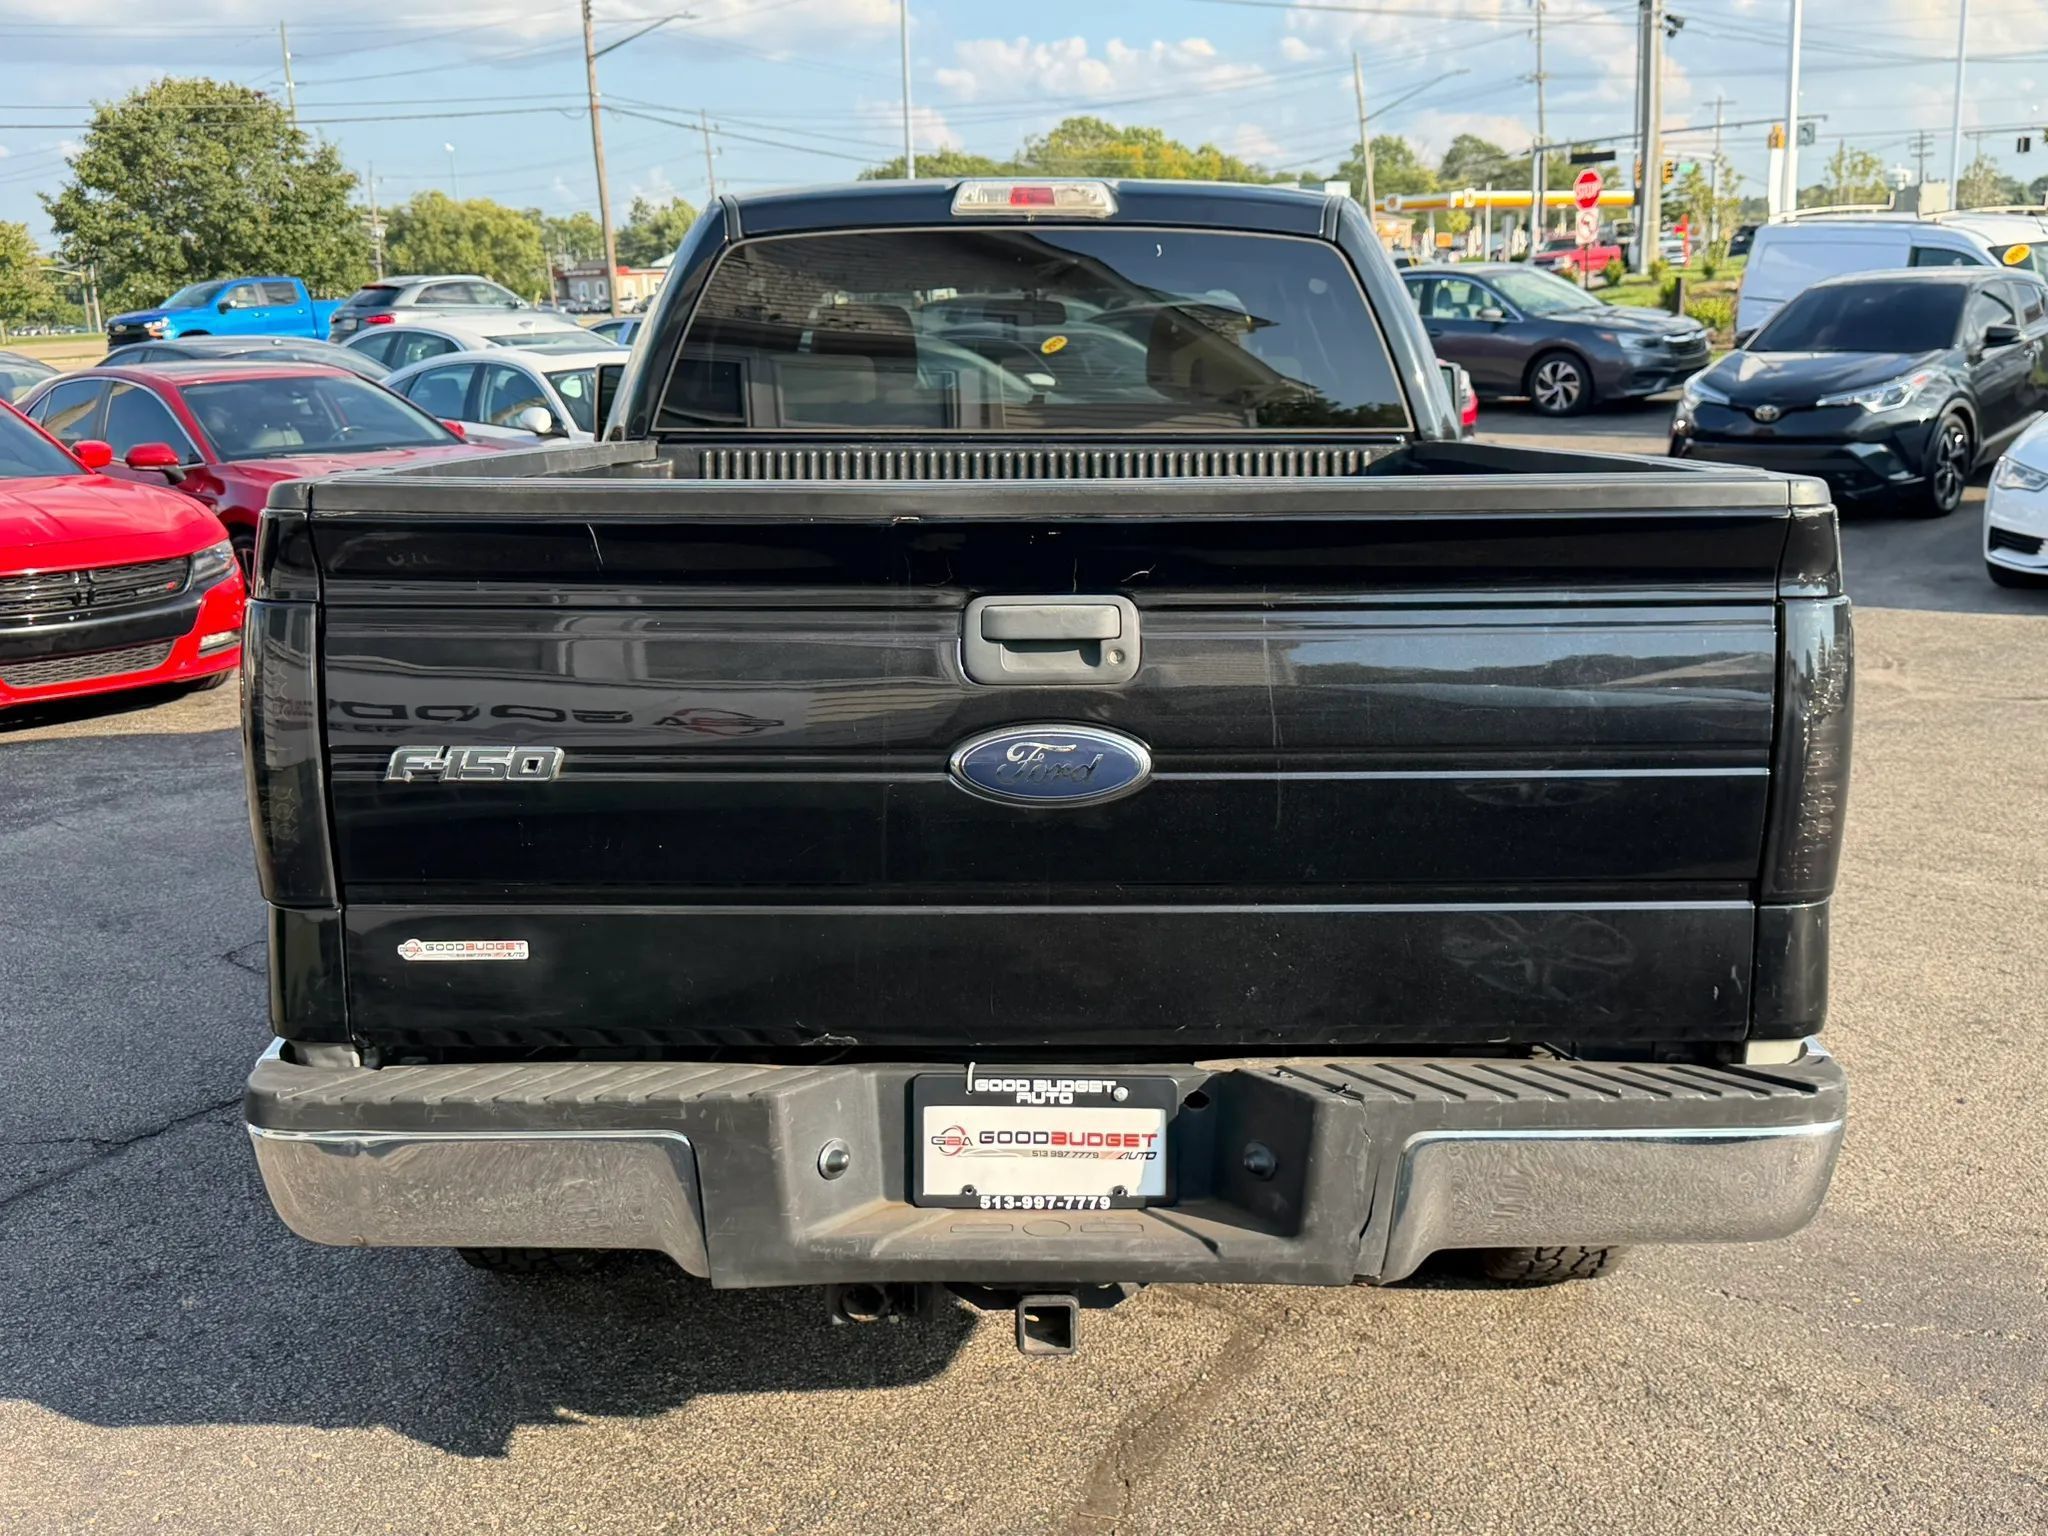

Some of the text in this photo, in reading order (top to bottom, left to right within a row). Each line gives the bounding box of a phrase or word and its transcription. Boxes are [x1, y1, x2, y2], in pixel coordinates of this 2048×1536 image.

[384, 746, 566, 783] F-150
[996, 741, 1104, 786] Ford
[425, 942, 525, 951] GOODBUDGET
[974, 1079, 1117, 1093] GOOD BUDGET
[1016, 1092, 1074, 1104] AUTO
[979, 1131, 1158, 1148] GOODBUDGET
[1116, 1151, 1158, 1161] AUTO
[980, 1195, 1111, 1210] 513-997-7779
